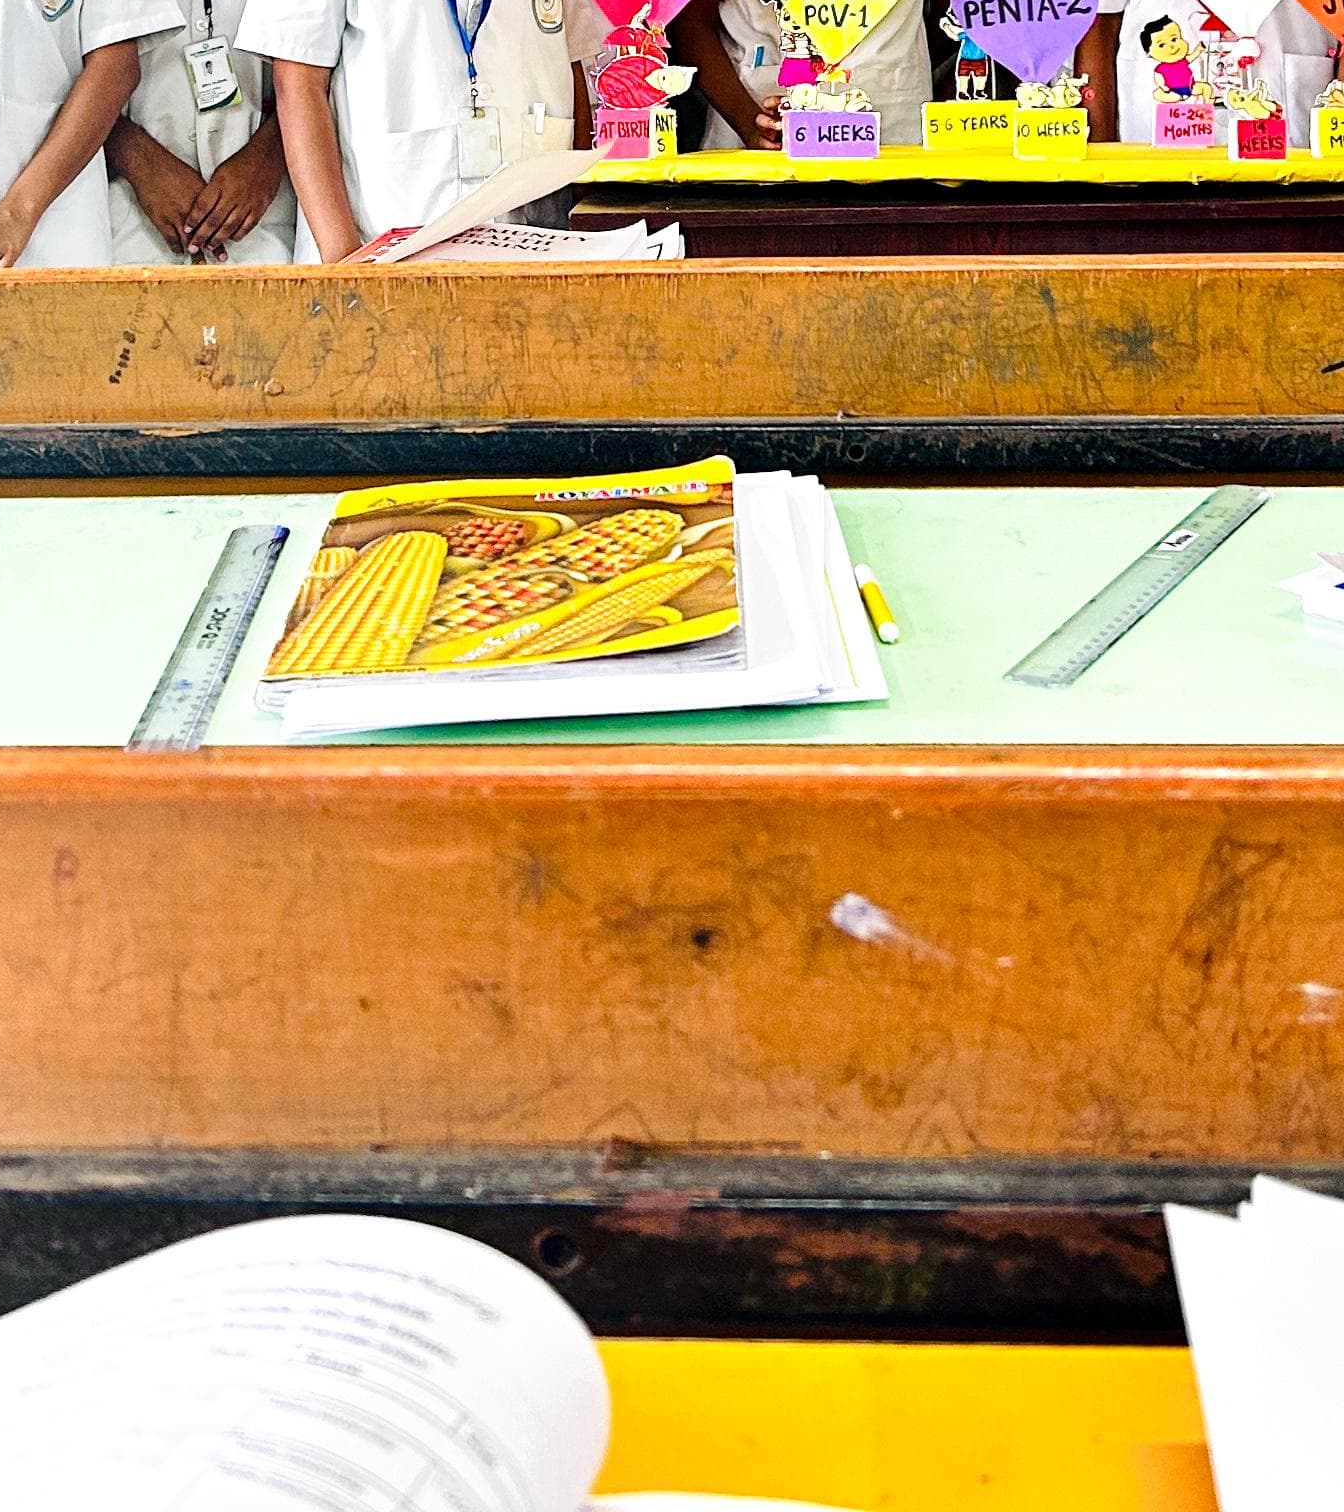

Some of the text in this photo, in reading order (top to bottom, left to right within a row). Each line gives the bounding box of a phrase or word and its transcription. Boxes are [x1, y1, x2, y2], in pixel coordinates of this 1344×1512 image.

[805, 4, 868, 27] PCV-1
[599, 120, 650, 139] AT BIRTH
[960, 114, 1009, 131] YEARS
[1037, 120, 1081, 137] WEEKS
[795, 125, 875, 143] 6 WEEKS
[1164, 124, 1213, 140] MONTHS
[1238, 135, 1286, 153] WEEKS
